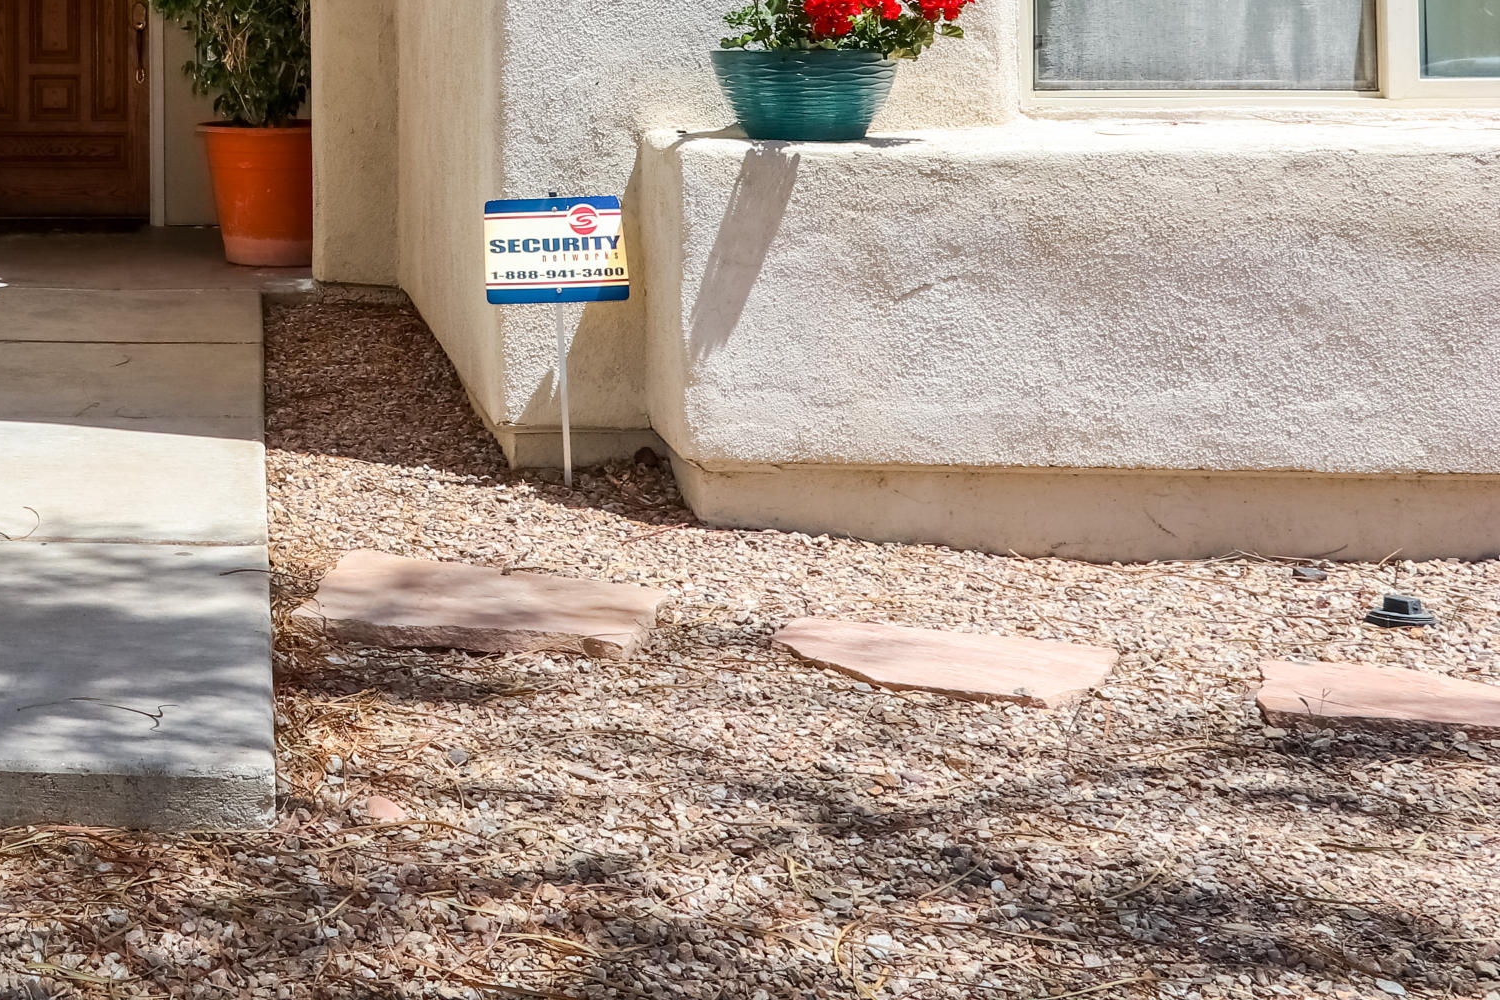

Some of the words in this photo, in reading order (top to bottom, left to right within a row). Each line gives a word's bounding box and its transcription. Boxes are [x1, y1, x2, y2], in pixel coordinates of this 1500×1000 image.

[489, 235, 621, 254] SECURITY
[542, 251, 619, 262] networks
[491, 267, 625, 280] 1-888-941-3400
